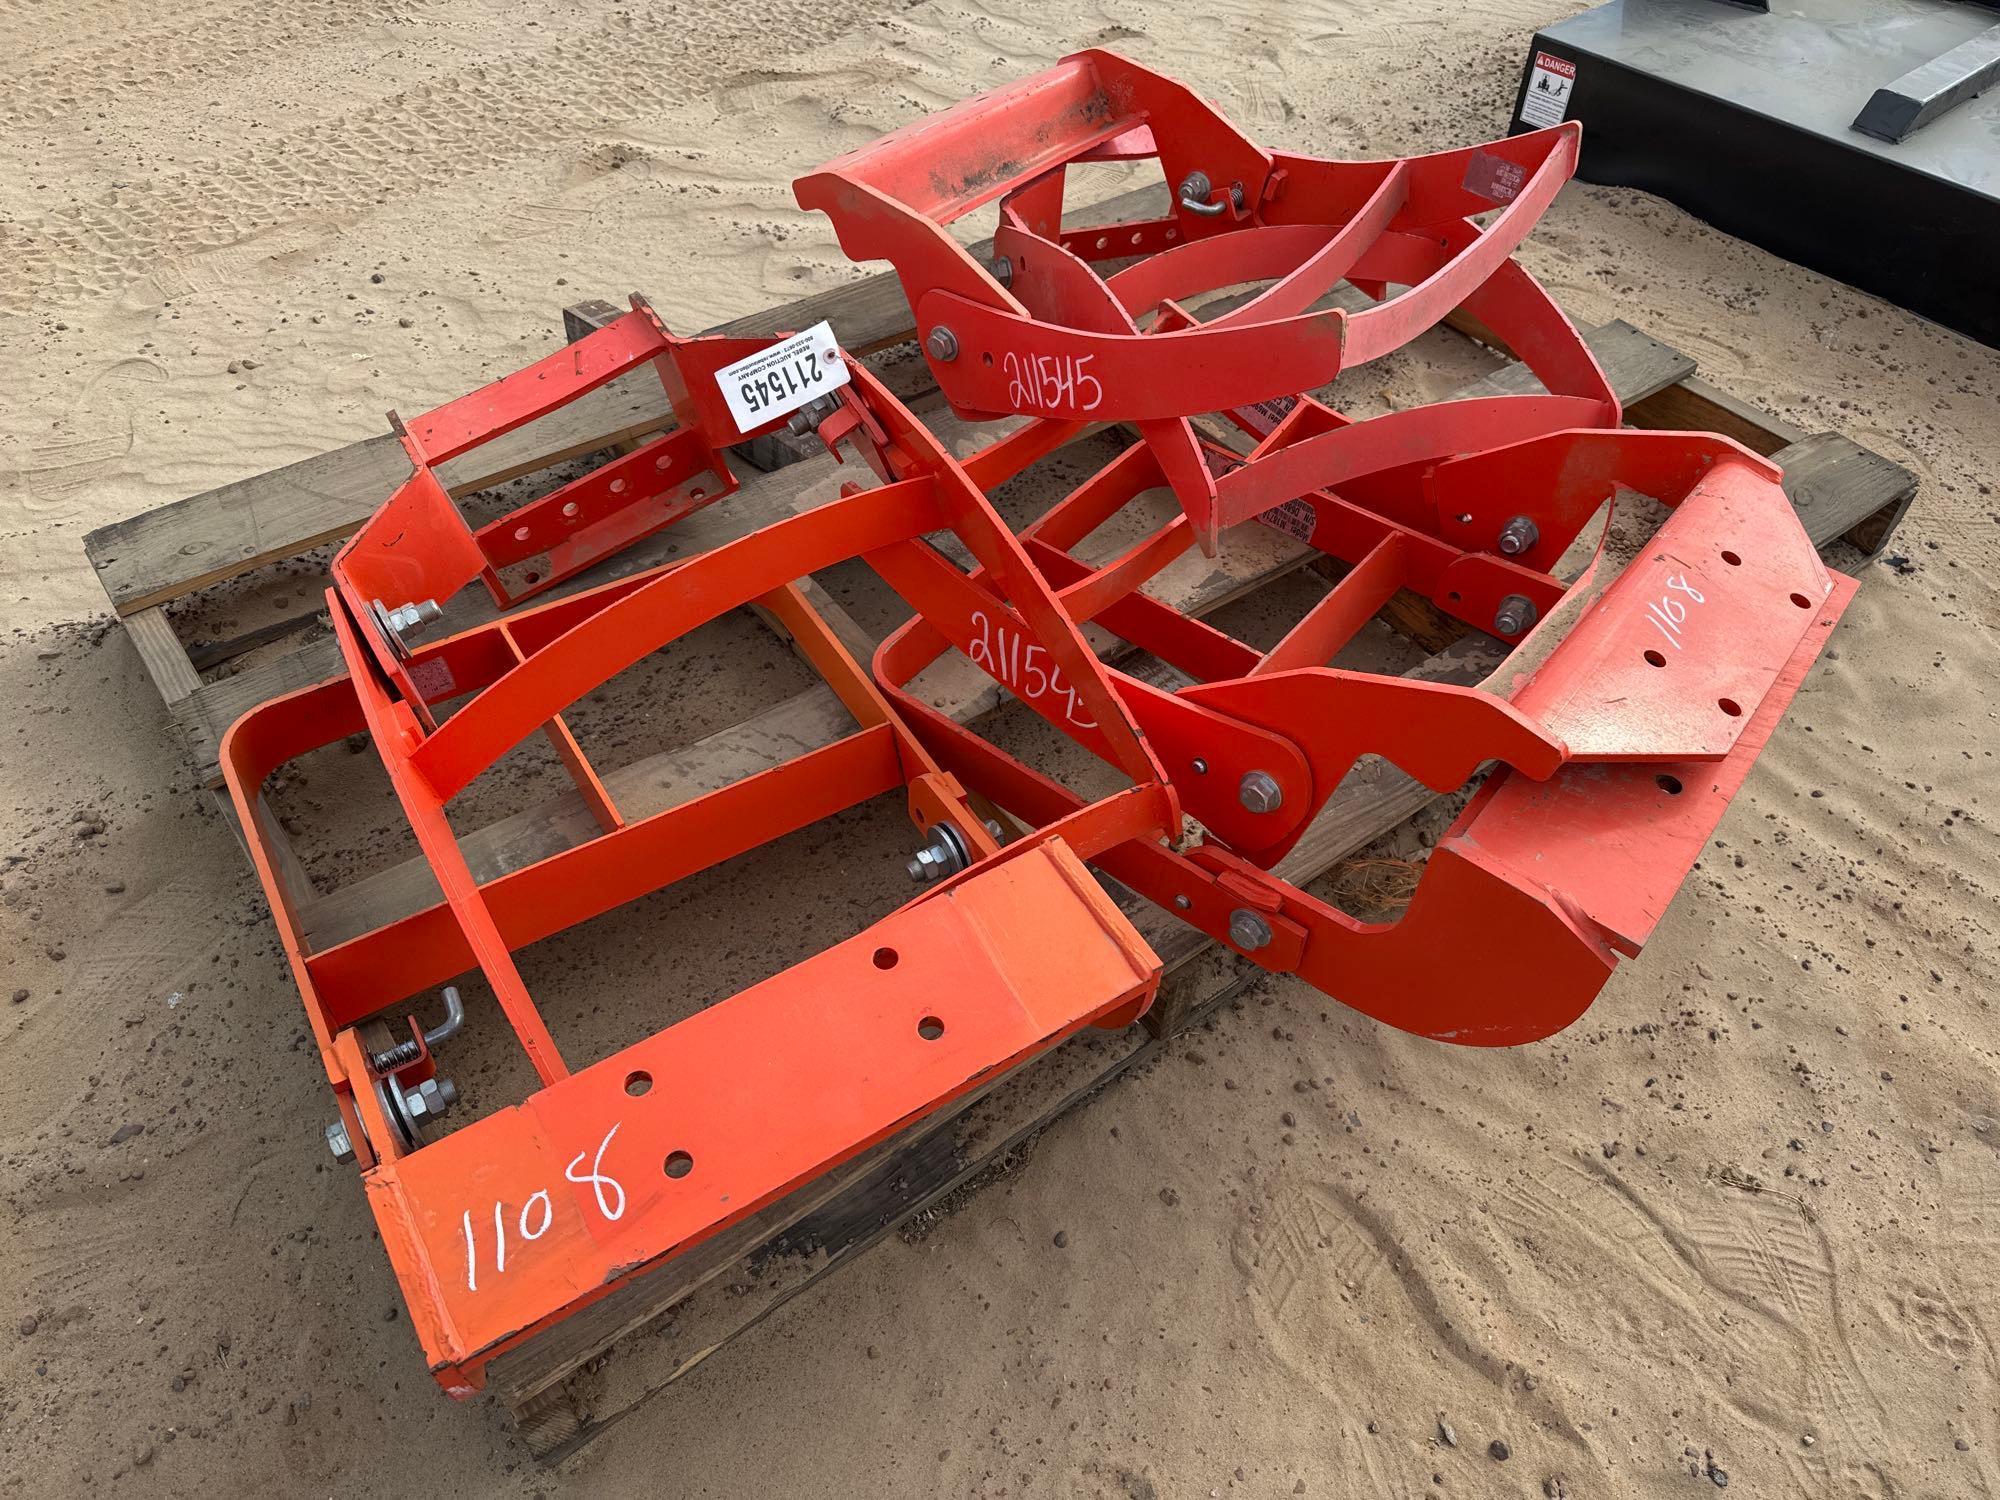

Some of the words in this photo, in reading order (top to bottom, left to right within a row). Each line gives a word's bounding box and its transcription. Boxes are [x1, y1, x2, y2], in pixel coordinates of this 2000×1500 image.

[1544, 58, 1576, 77] DANGER
[793, 344, 810, 356] REBEL
[766, 353, 792, 368] AUCTION
[738, 364, 766, 381] COMPANY
[1003, 351, 1103, 411] 211545
[741, 352, 823, 413] 211545
[1303, 512, 1316, 526] S/N
[1290, 526, 1308, 542] Model
[1644, 571, 1705, 651] 1108
[463, 1120, 626, 1292] 1108
